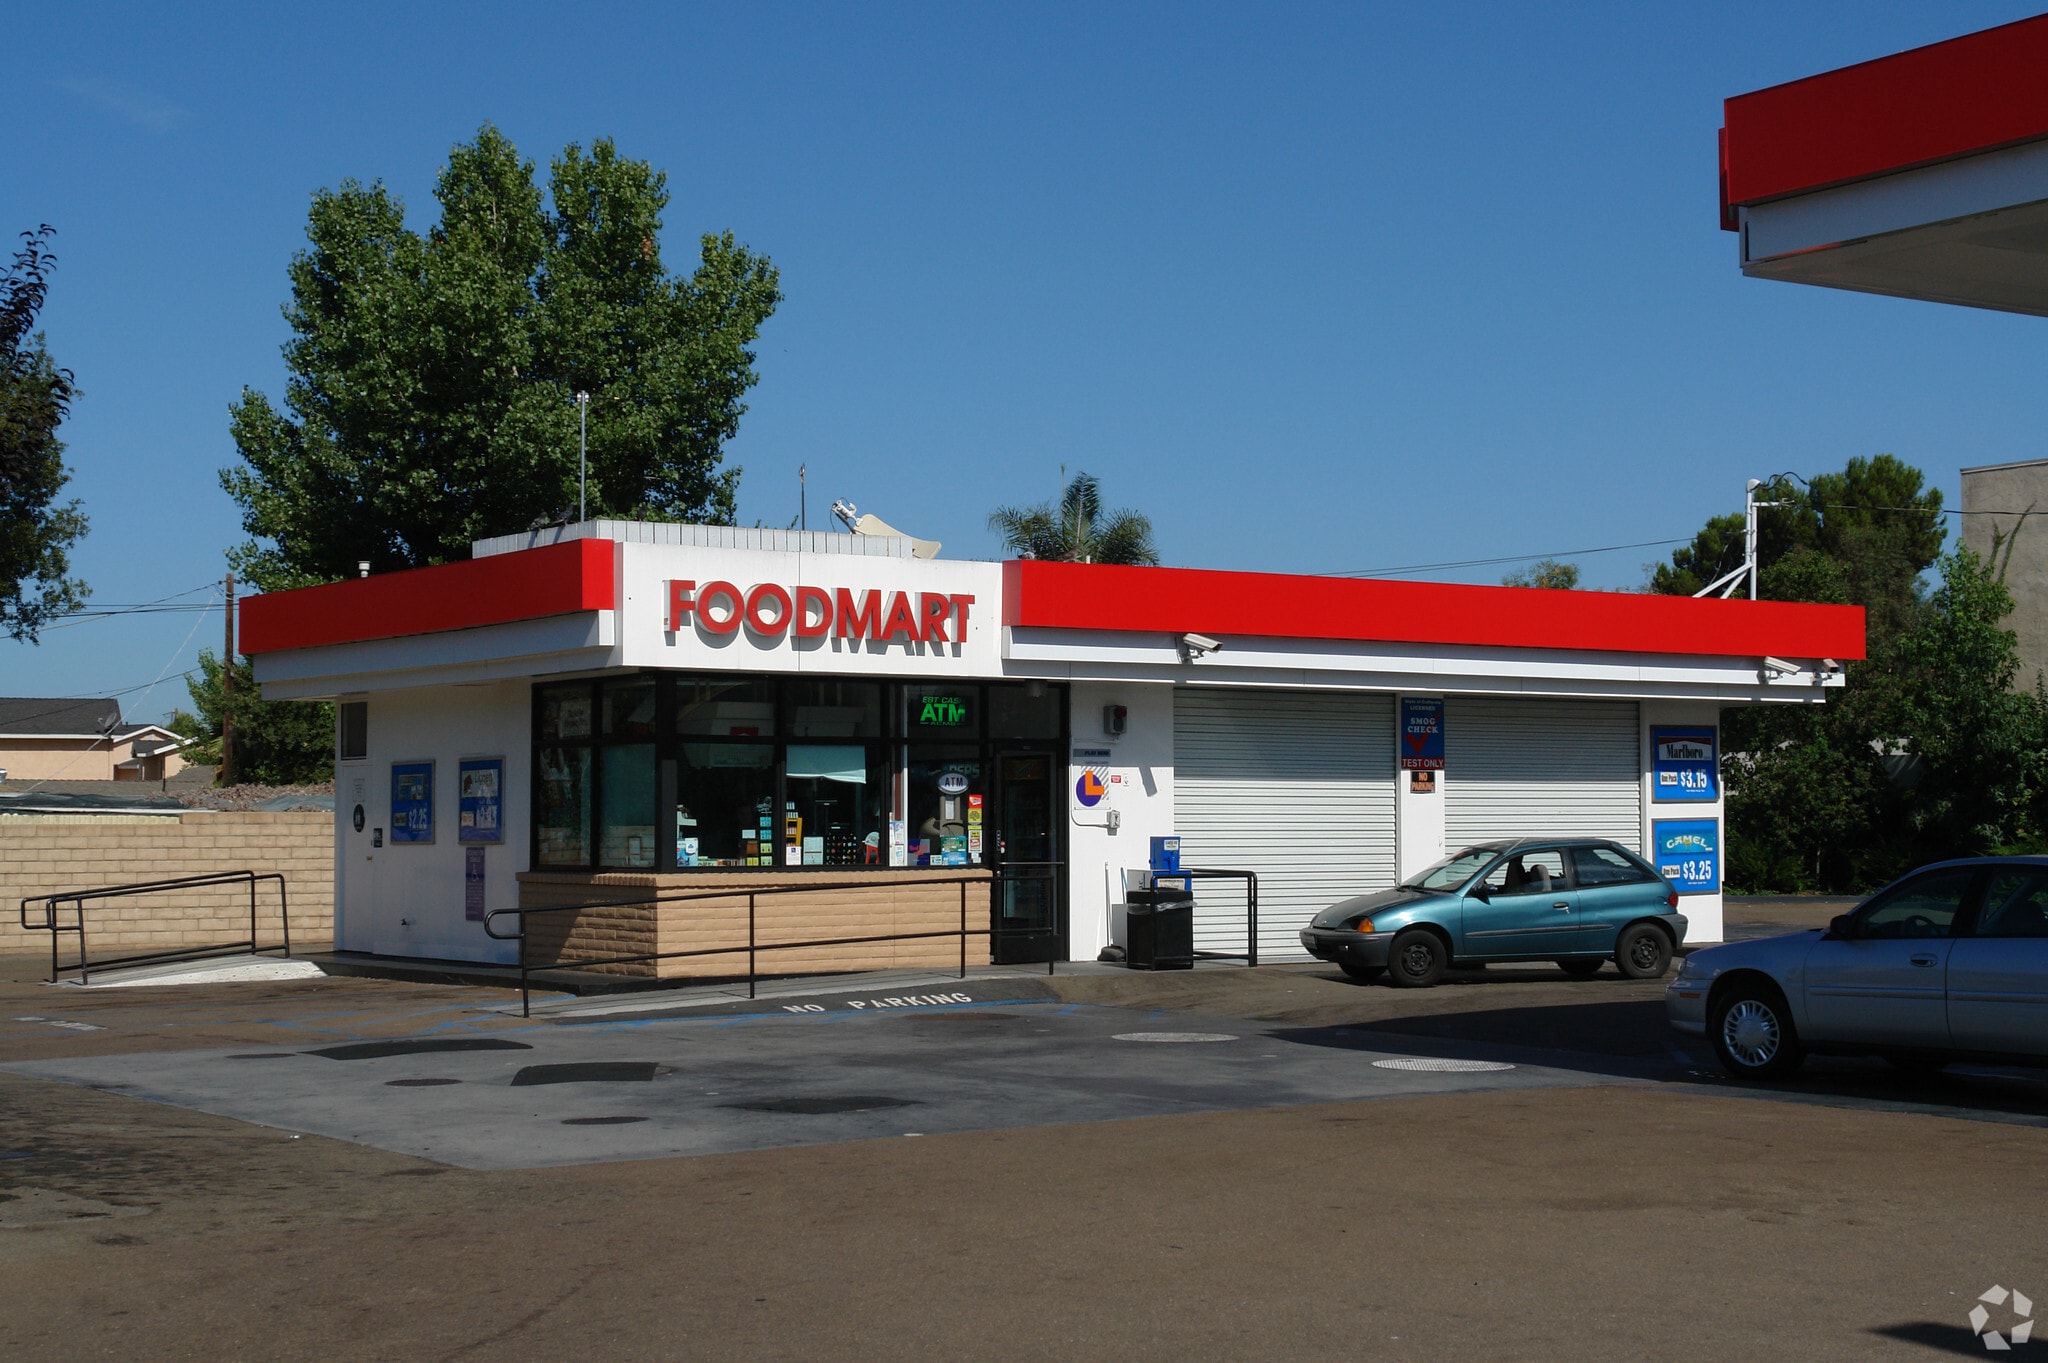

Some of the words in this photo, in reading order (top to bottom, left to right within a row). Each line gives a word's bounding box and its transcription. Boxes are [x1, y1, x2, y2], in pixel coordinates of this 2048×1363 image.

[663, 579, 975, 643] FOODMART
[920, 703, 966, 722] ATM
[1410, 717, 1436, 725] SMOG
[1407, 726, 1439, 734] CHECK
[1666, 744, 1703, 759] Marlboro
[1402, 758, 1422, 767] TEST
[1423, 758, 1444, 768] ONLY
[944, 777, 964, 787] ATM
[1418, 772, 1428, 781] NO
[1680, 769, 1707, 788] $3.15
[1666, 835, 1708, 849] CAMEL
[1683, 860, 1712, 880] $3.25
[782, 1004, 826, 1013] NO
[847, 992, 973, 1010] PARKING
